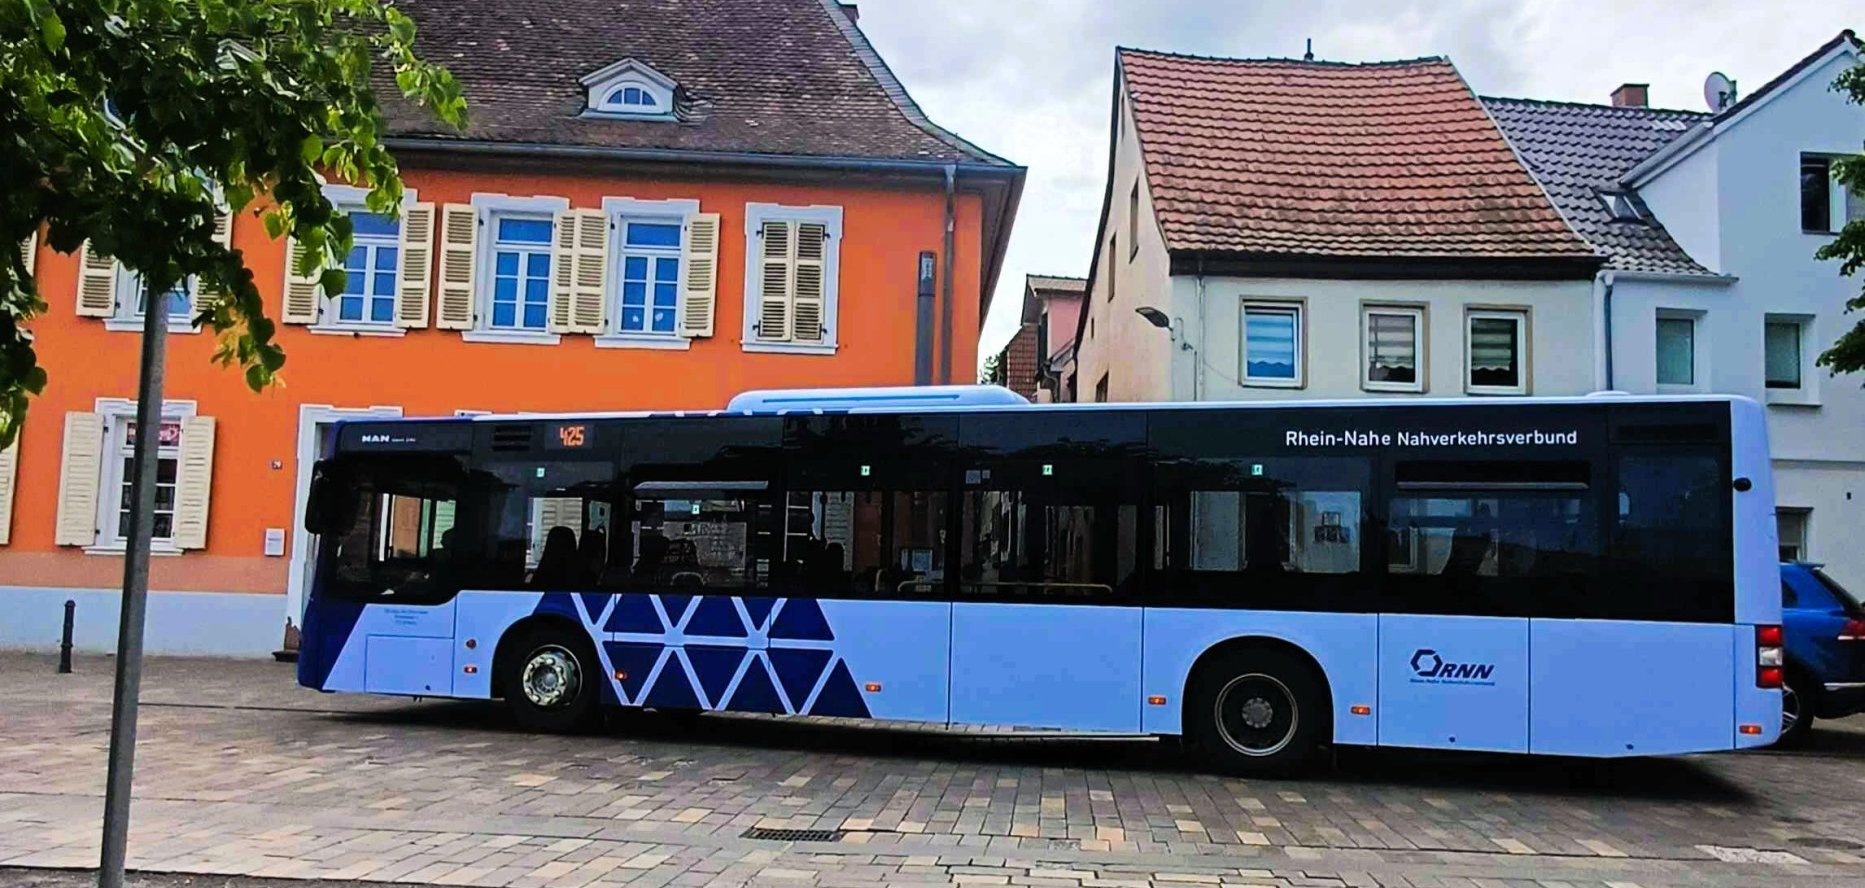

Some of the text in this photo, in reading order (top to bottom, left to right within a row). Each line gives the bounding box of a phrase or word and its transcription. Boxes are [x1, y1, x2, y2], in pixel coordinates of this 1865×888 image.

[560, 426, 585, 446] 425
[1285, 430, 1578, 446] Rhein-Nahe Nahverkehrsverbund
[1439, 663, 1495, 679] RNN
